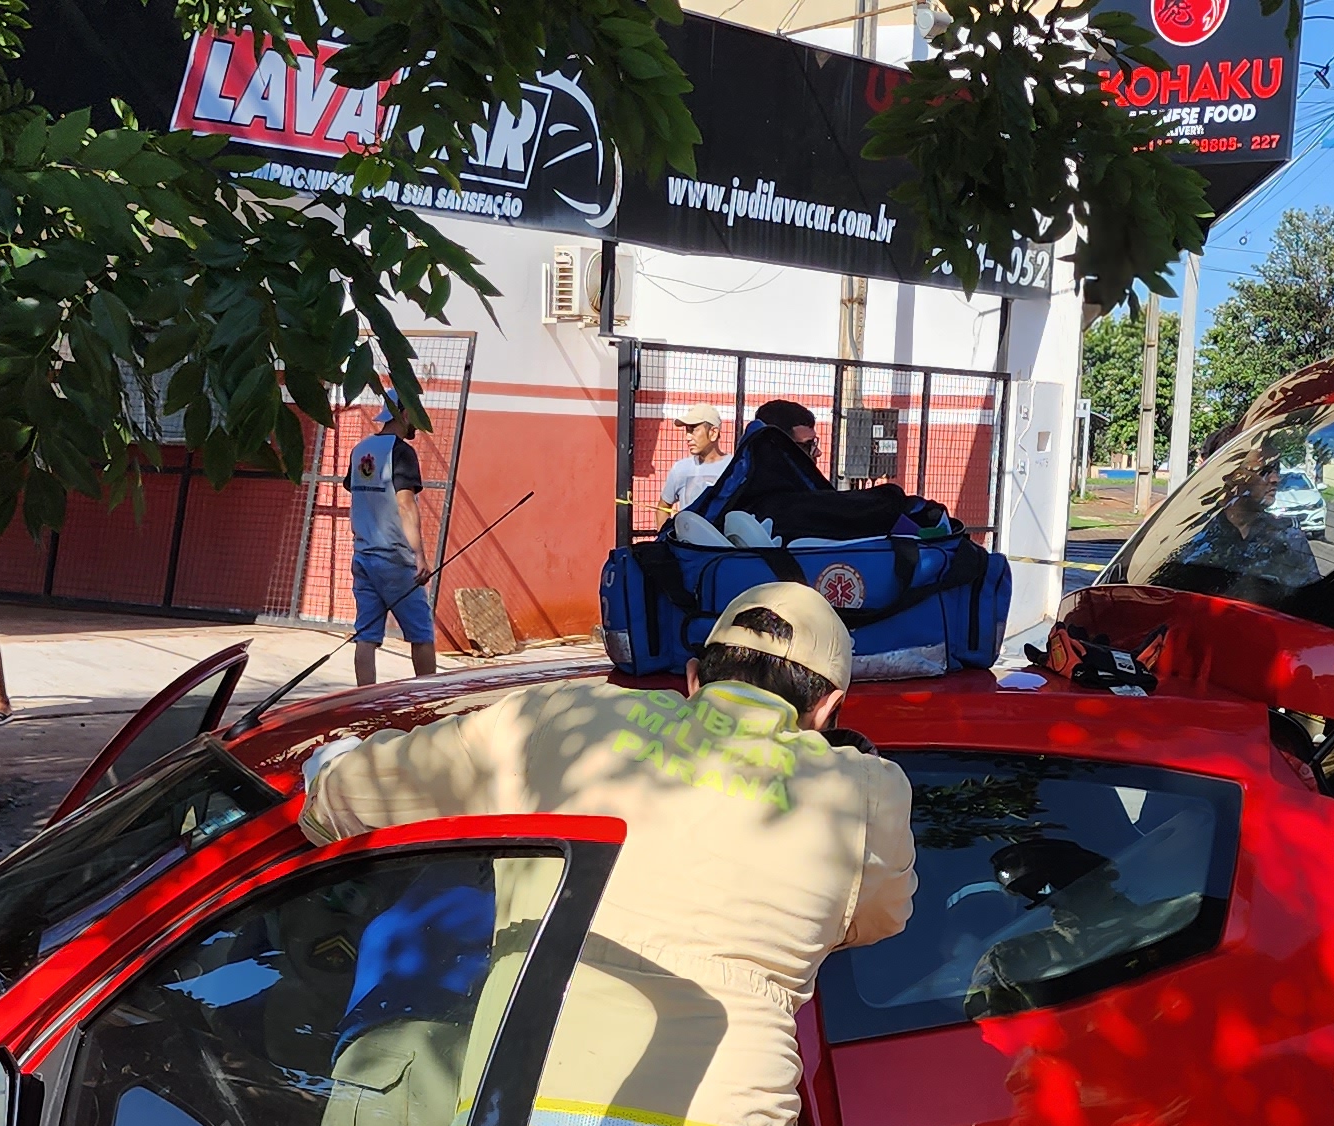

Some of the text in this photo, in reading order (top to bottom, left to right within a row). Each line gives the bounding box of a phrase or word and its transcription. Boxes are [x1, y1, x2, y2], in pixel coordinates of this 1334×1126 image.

[1098, 57, 1283, 107] KOHAKU
[1204, 104, 1256, 124] FOOD
[435, 187, 523, 220] SATISFAÇÃO
[668, 176, 896, 243] www.judilavacar.com.br
[612, 729, 790, 812] PARANÁ
